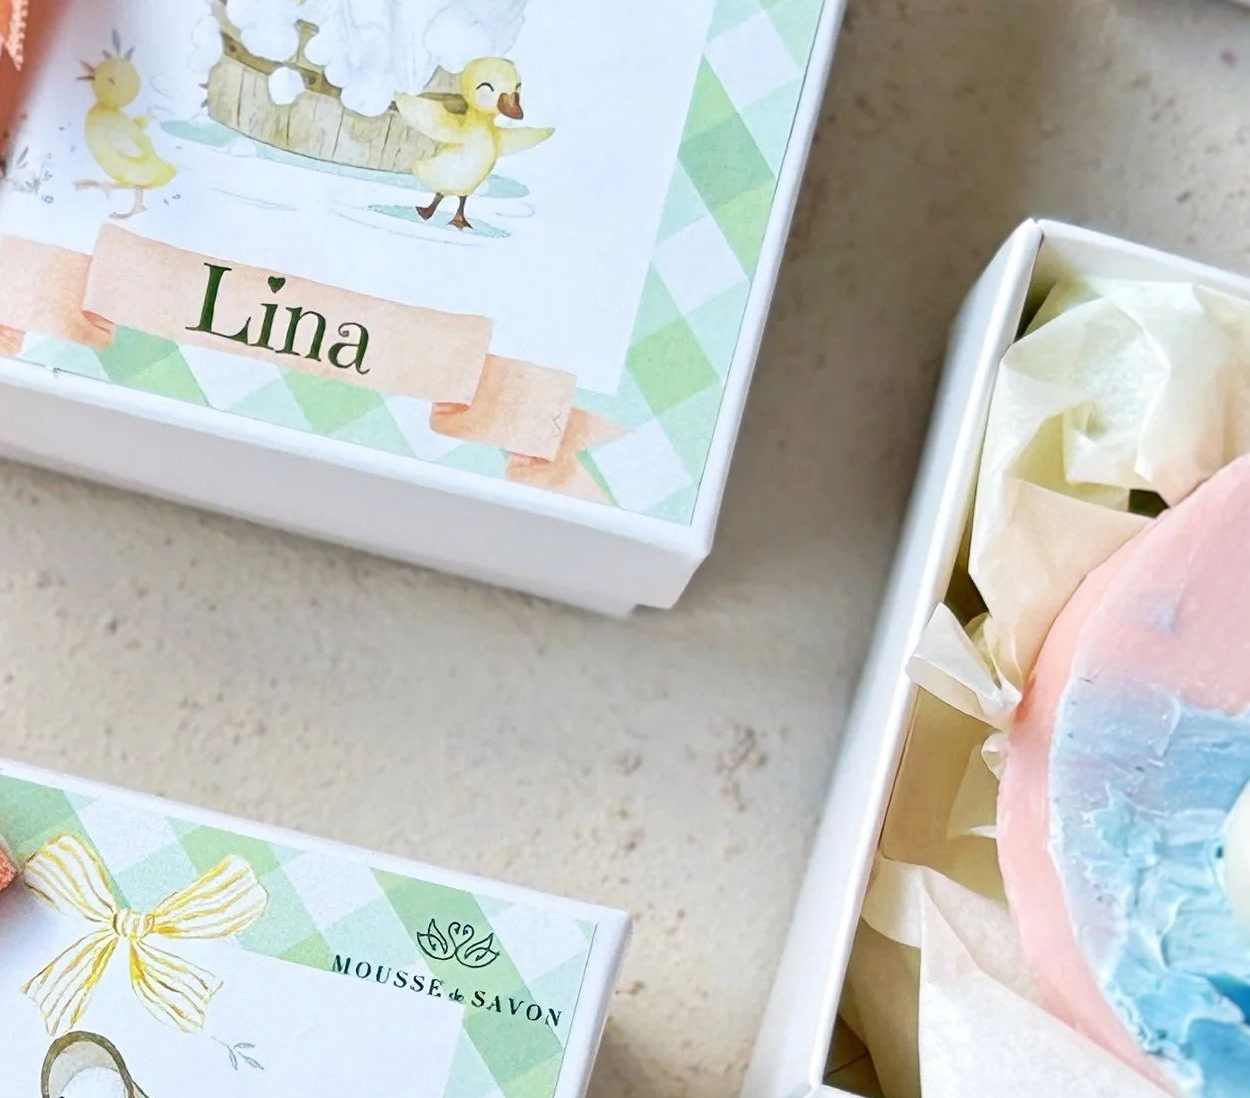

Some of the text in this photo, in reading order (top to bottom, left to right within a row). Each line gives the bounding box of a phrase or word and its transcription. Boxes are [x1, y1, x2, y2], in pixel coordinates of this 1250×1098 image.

[184, 261, 371, 375] Lina
[331, 954, 563, 1027] MOUSSE de SAVON
